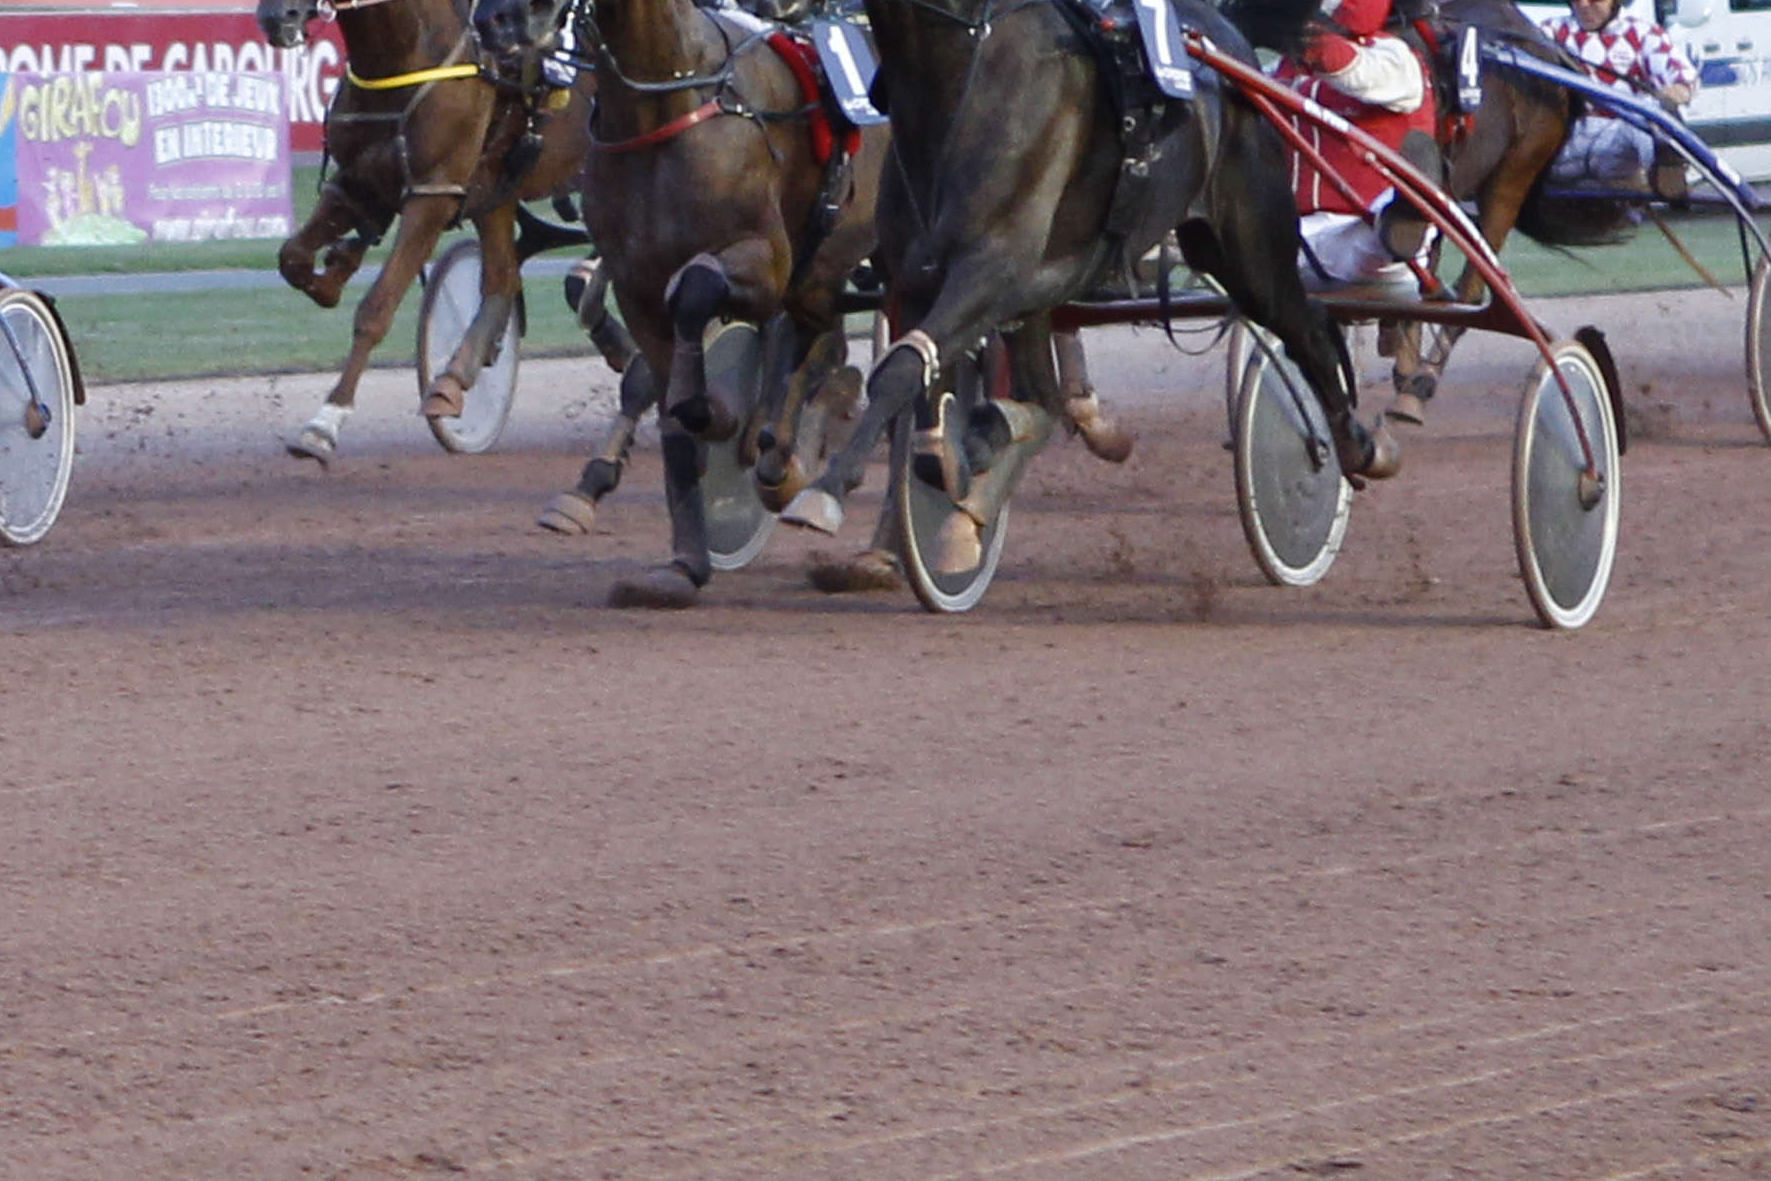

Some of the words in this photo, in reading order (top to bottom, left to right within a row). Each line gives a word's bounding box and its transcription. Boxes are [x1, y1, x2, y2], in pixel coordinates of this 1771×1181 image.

[828, 25, 867, 96] 1
[1460, 26, 1479, 88] 4
[154, 126, 181, 164] EN
